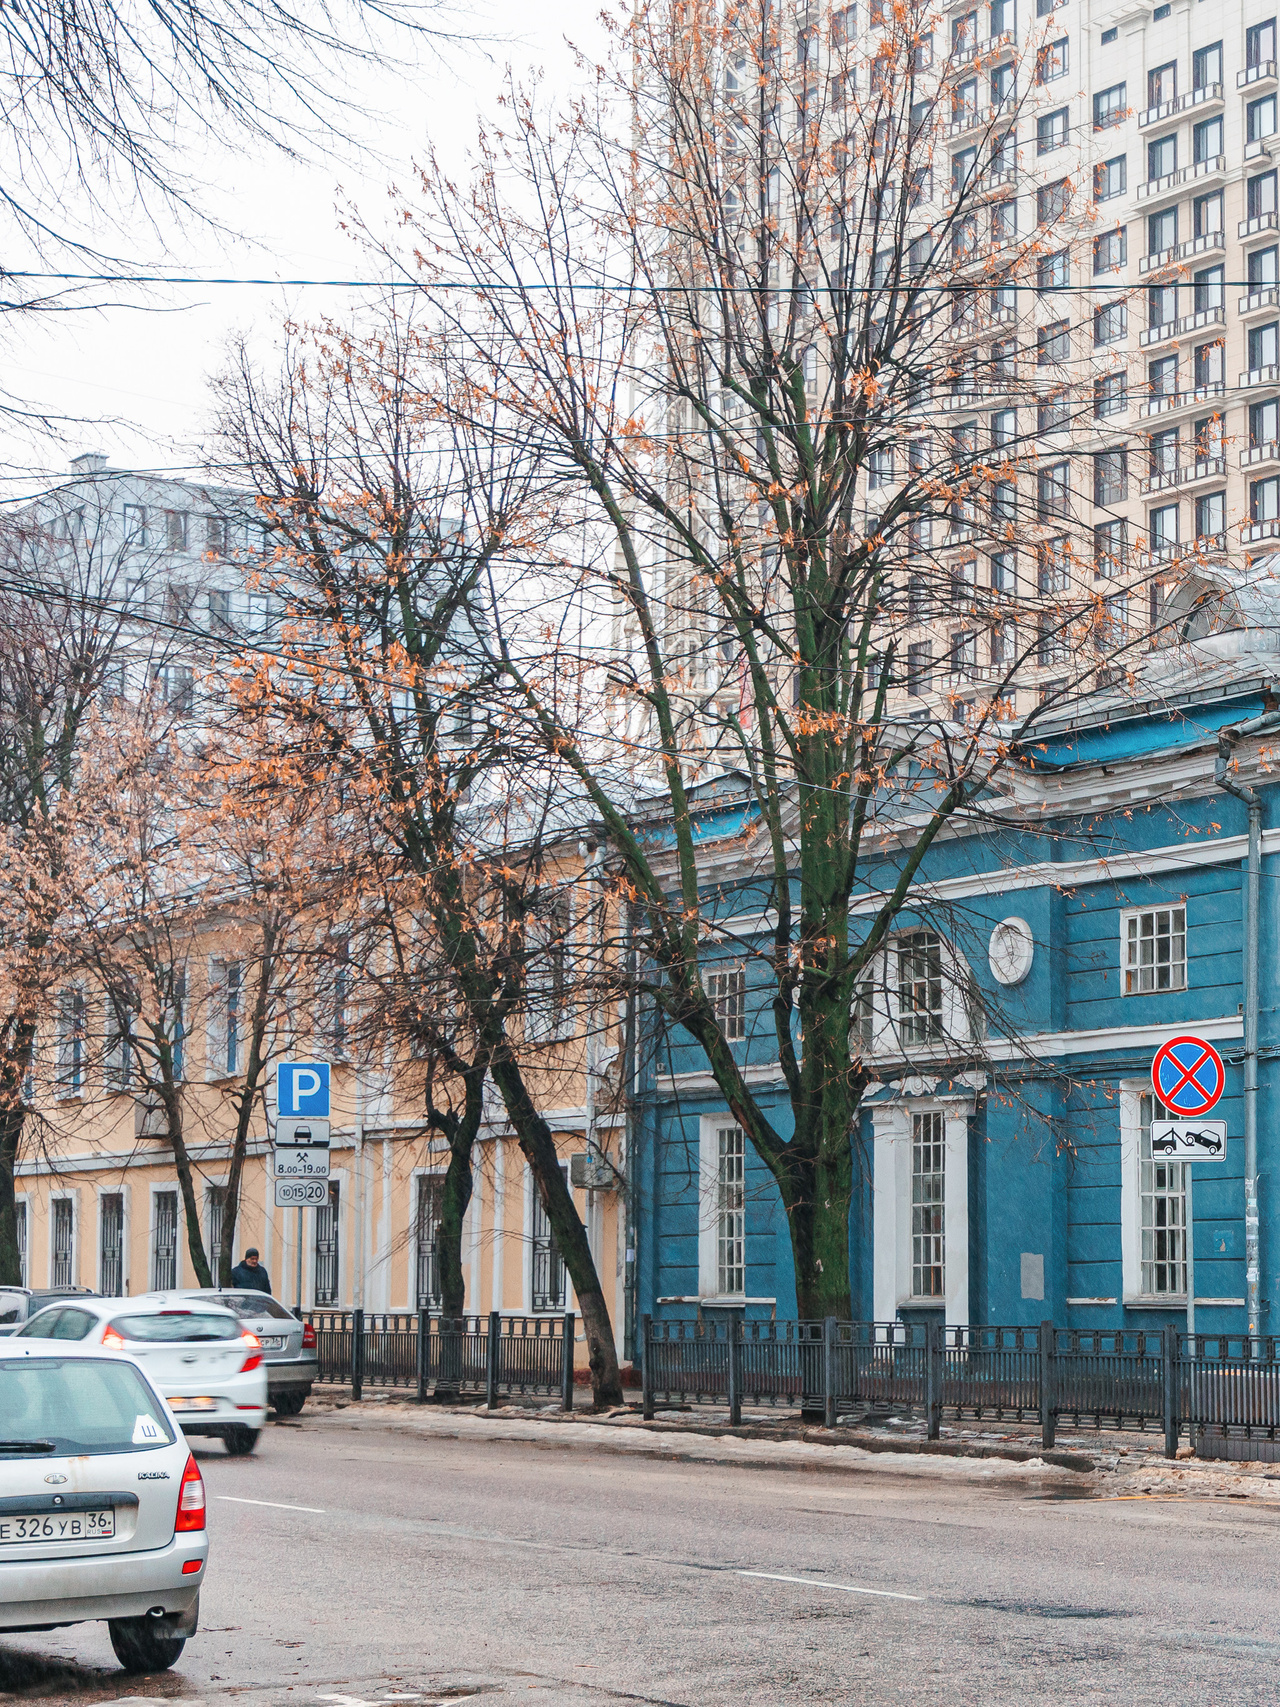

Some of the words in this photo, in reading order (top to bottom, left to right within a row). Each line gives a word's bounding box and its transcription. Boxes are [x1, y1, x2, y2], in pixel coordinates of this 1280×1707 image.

[292, 1068, 322, 1112] P
[277, 1164, 327, 1174] 8.00-19.00
[141, 1425, 157, 1438] Ш
[88, 1513, 107, 1528] 36
